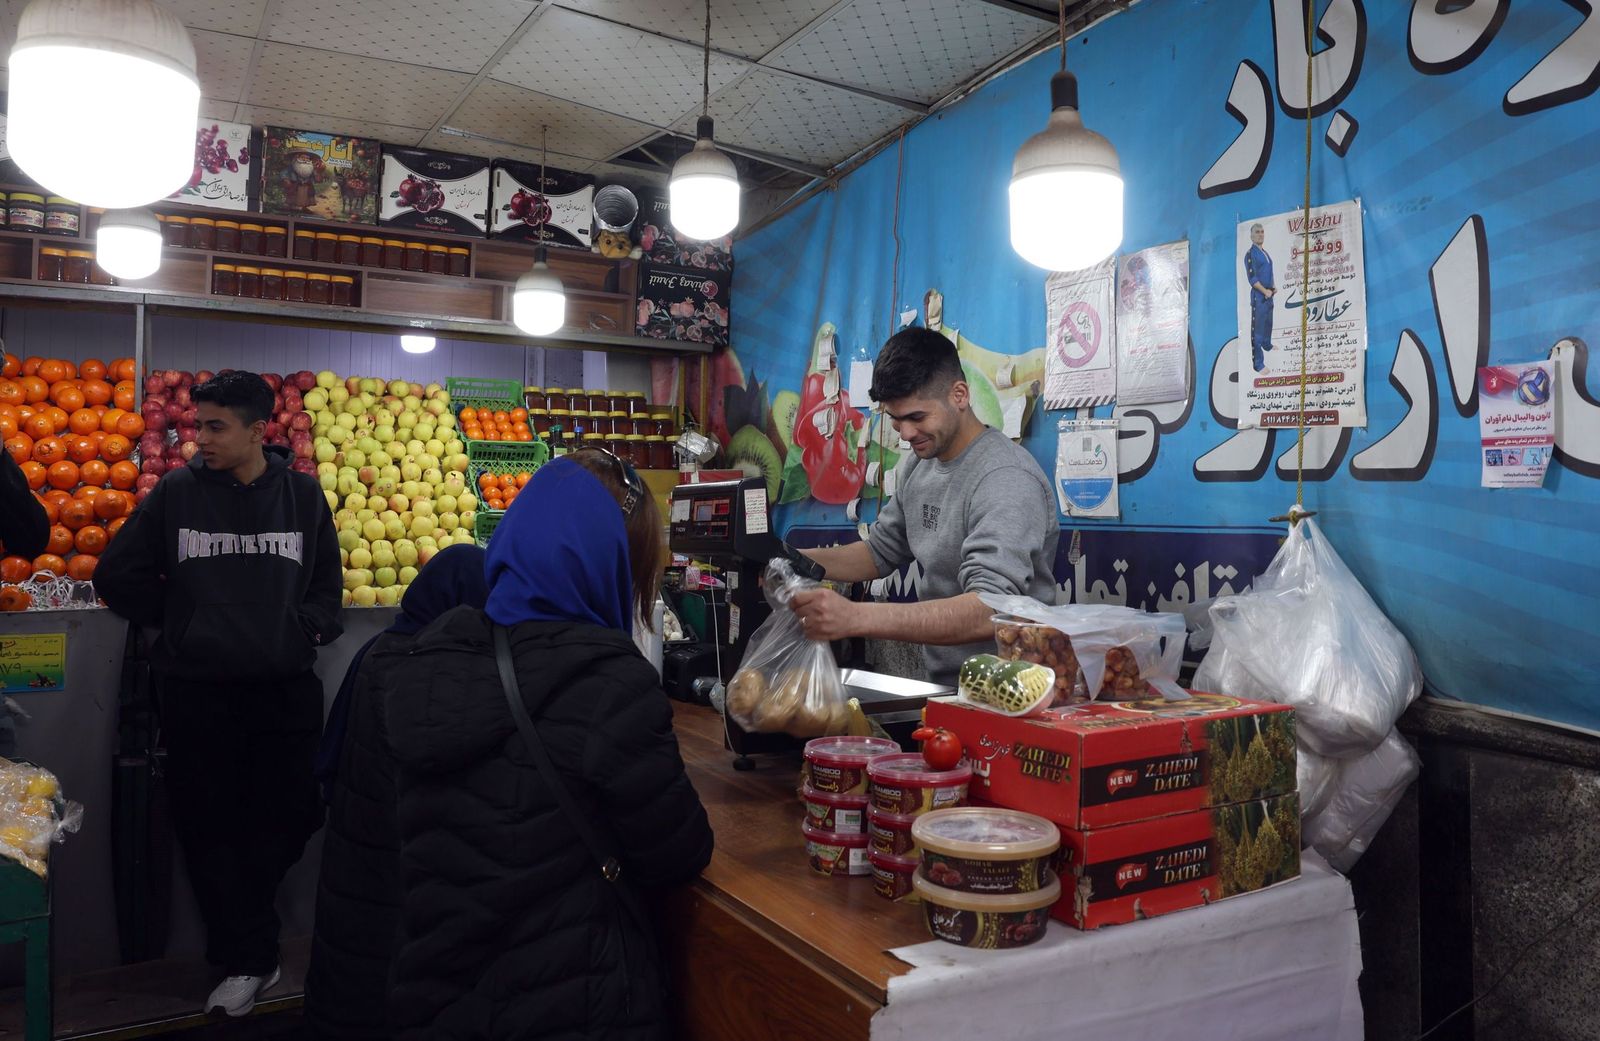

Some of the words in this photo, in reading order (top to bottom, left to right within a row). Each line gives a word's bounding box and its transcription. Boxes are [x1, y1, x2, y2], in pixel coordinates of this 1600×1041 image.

[1288, 213, 1342, 232] Wushu
[649, 275, 678, 289] Fruit
[1340, 272, 1357, 282] توسط
[679, 276, 711, 293] Shiraz
[1314, 334, 1328, 342] کشور
[1329, 331, 1348, 340] قهرمان
[1341, 398, 1356, 406] شهید
[1320, 414, 1335, 424] شماره
[1512, 413, 1535, 423] والیبال
[1014, 743, 1071, 769] ZAHEDI
[1022, 760, 1062, 783] DATE
[1145, 757, 1199, 777] ZAHEDI
[1110, 774, 1133, 786] NEW
[1154, 773, 1192, 792] DATE
[1154, 846, 1207, 870] ZAHEDI
[1119, 868, 1142, 881] NEW
[1164, 864, 1201, 885] DATE
